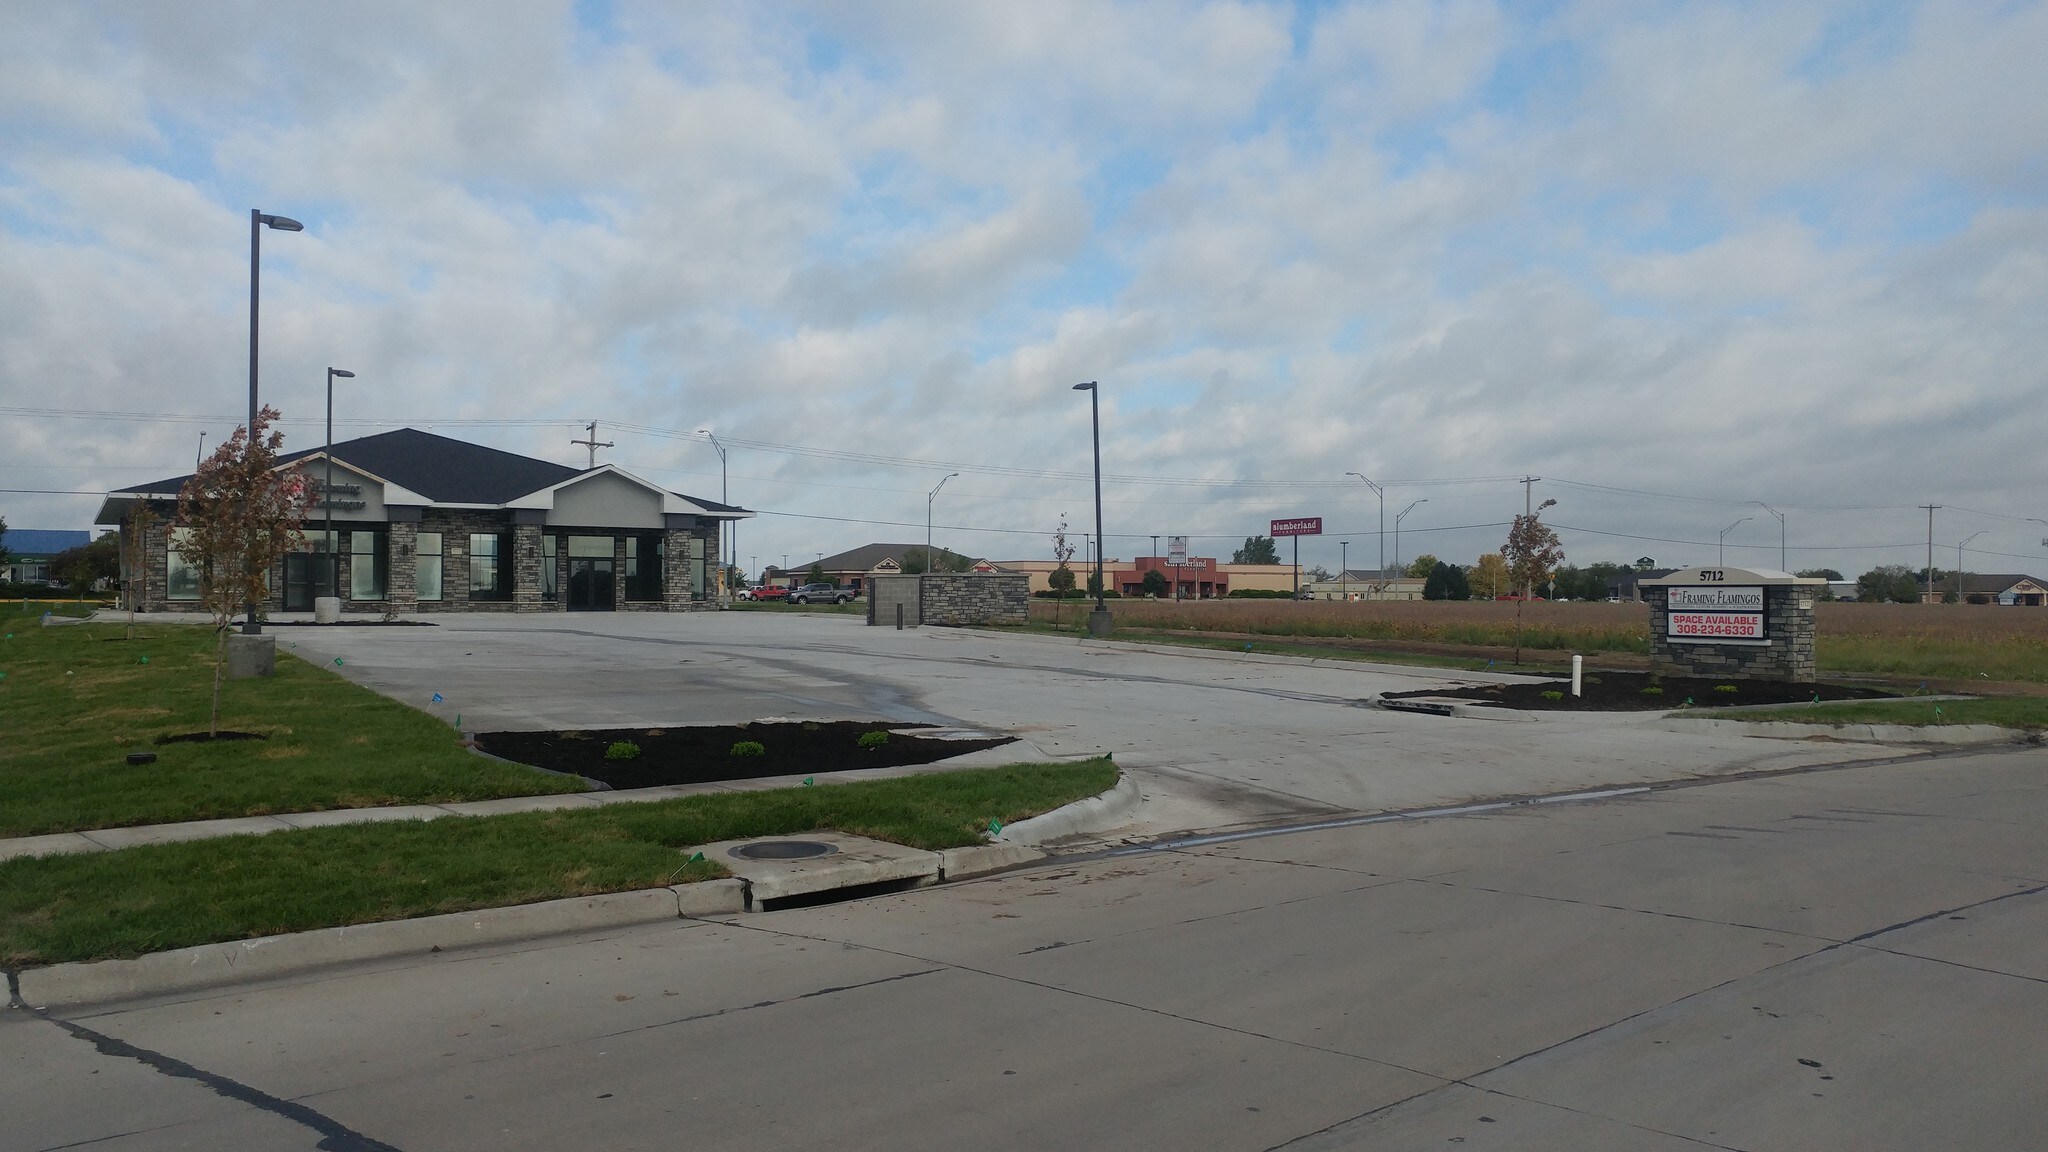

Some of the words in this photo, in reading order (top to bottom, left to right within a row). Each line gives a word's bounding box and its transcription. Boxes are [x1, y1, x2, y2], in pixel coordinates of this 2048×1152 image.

[1272, 520, 1317, 531] slumberland
[1699, 570, 1724, 582] 5712
[1682, 590, 1715, 604] FRAMING
[1717, 590, 1761, 605] FLAMINGOS
[1673, 615, 1703, 624] SPACE
[1705, 616, 1758, 625] AVAILABLE
[1677, 625, 1755, 635] 308-234-6330
